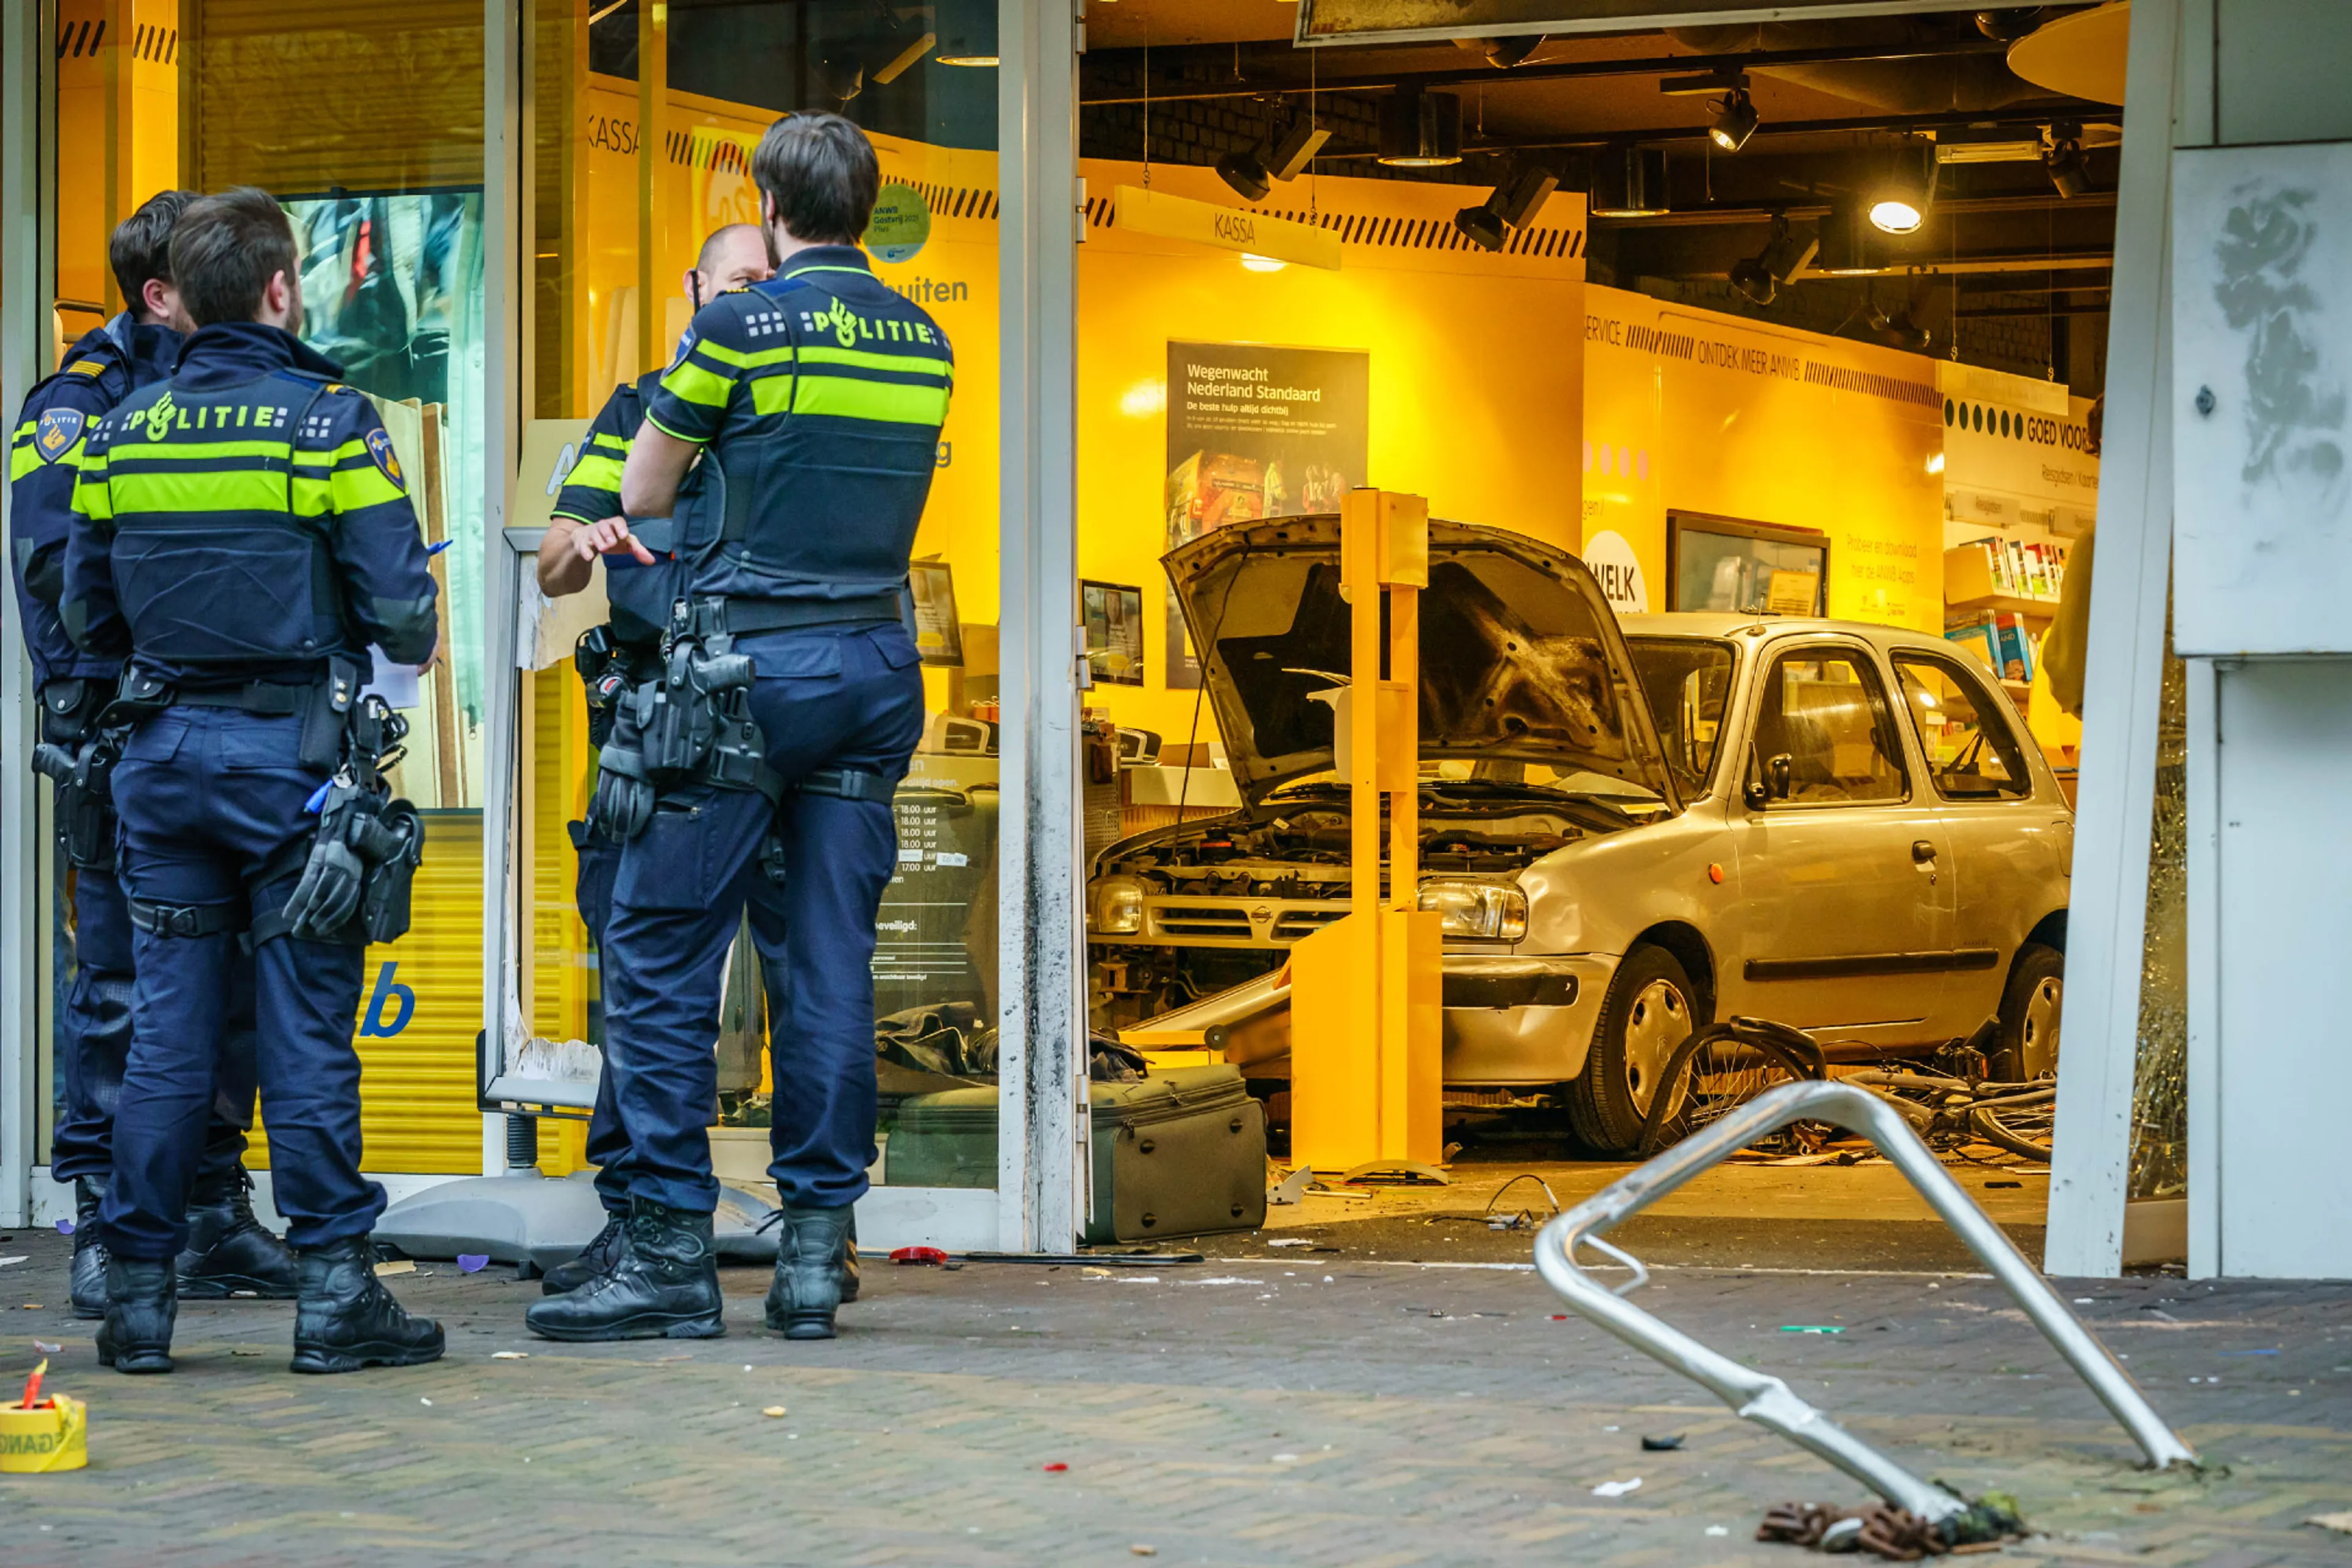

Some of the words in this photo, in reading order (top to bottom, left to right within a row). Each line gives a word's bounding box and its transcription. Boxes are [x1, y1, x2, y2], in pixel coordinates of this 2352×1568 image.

[1215, 213, 1256, 246] KASSA
[1585, 315, 1621, 346] ERVICE
[1698, 340, 1740, 370] ONTDEK
[1741, 349, 1768, 375] MEER
[1770, 354, 1800, 381] ANWB
[1187, 364, 1268, 381] Wegenwacht
[1188, 382, 1253, 398] Nederland
[1256, 385, 1321, 402] Standaard
[1186, 401, 1197, 410] De
[1199, 402, 1220, 411] beste
[1222, 403, 1238, 413] hulp
[1240, 404, 1259, 415] altijd
[1261, 405, 1289, 416] dichtbij
[2027, 417, 2057, 446] GOED
[901, 804, 921, 814] 18.00
[901, 816, 921, 826] 18.00
[923, 818, 937, 826] uur
[901, 827, 921, 837] 18.00
[901, 840, 921, 848] 18.00
